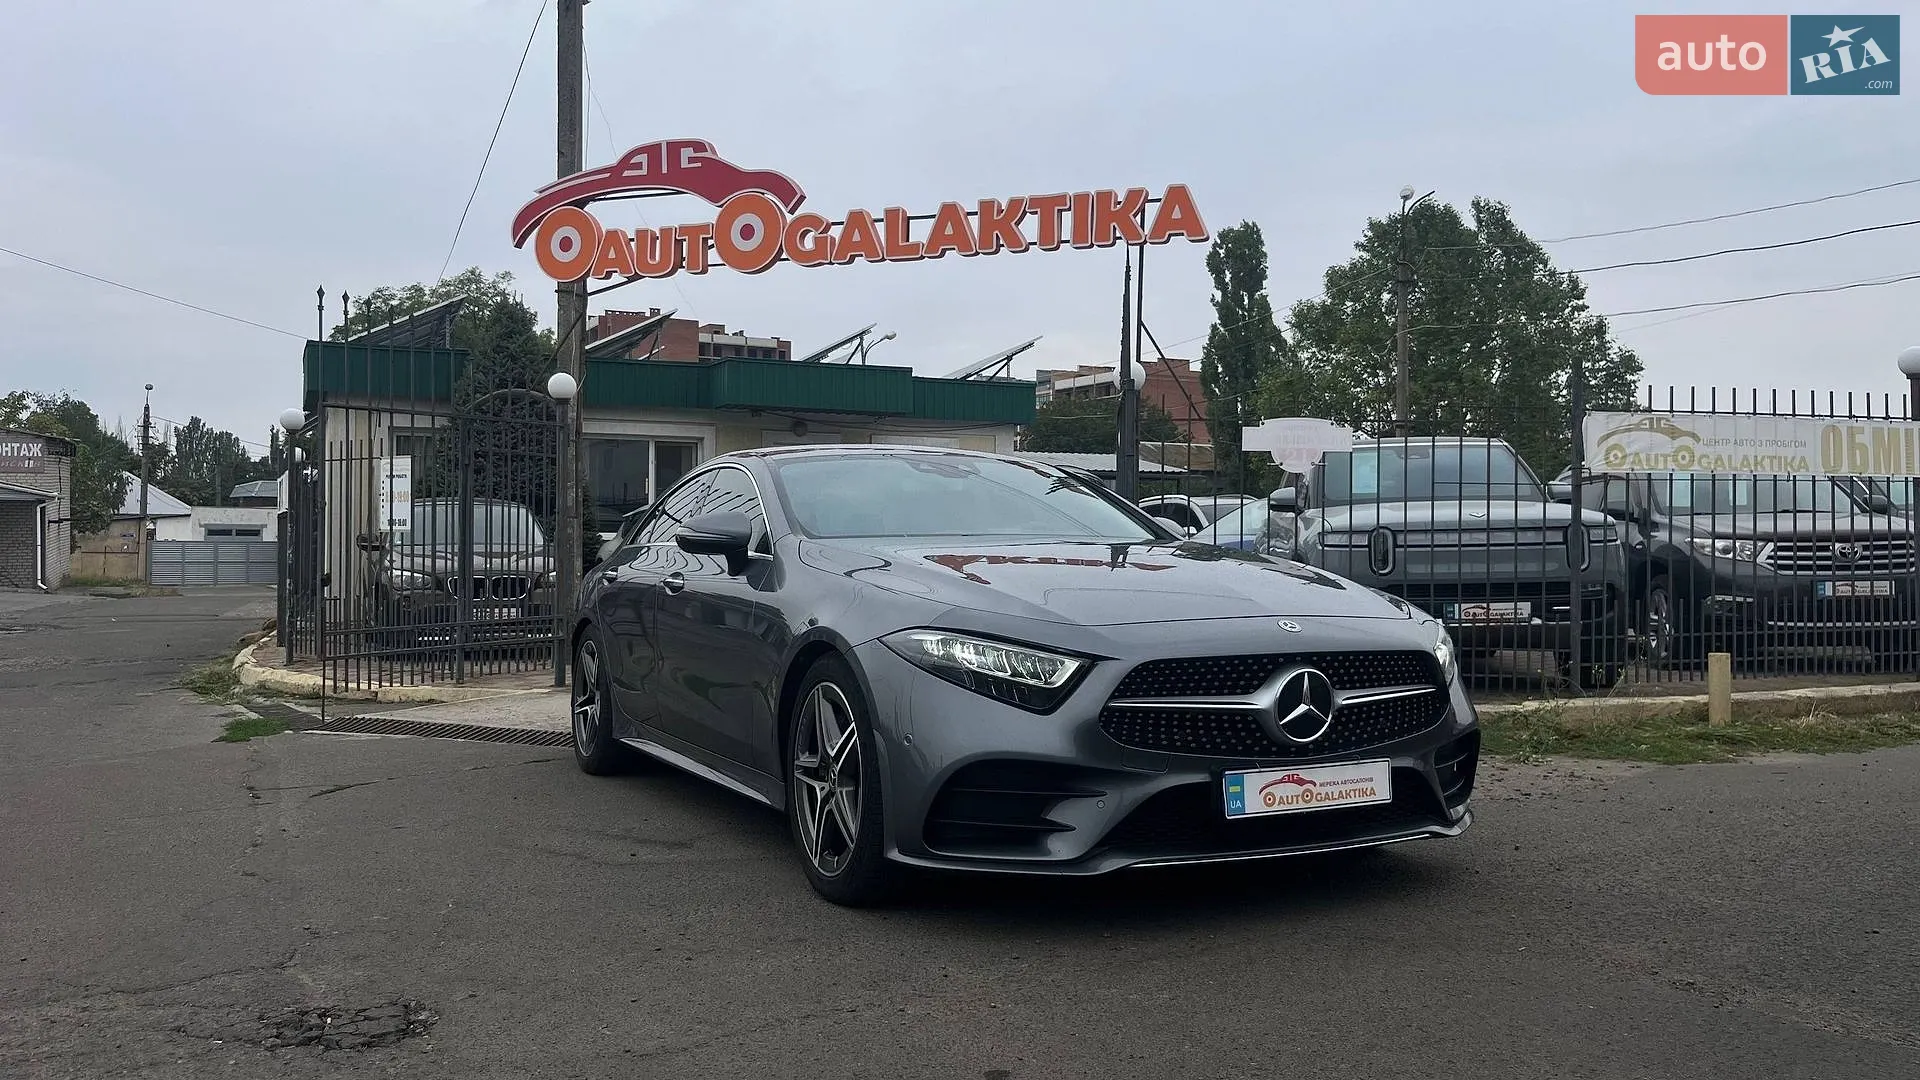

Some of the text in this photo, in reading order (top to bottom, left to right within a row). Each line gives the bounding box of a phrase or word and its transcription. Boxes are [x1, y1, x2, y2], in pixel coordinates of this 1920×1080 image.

[1702, 438, 1731, 448] ЦЕНТР
[1733, 438, 1756, 448] АВТО
[1765, 439, 1807, 449] ПРОБІГОМ
[1230, 799, 1242, 809] UA
